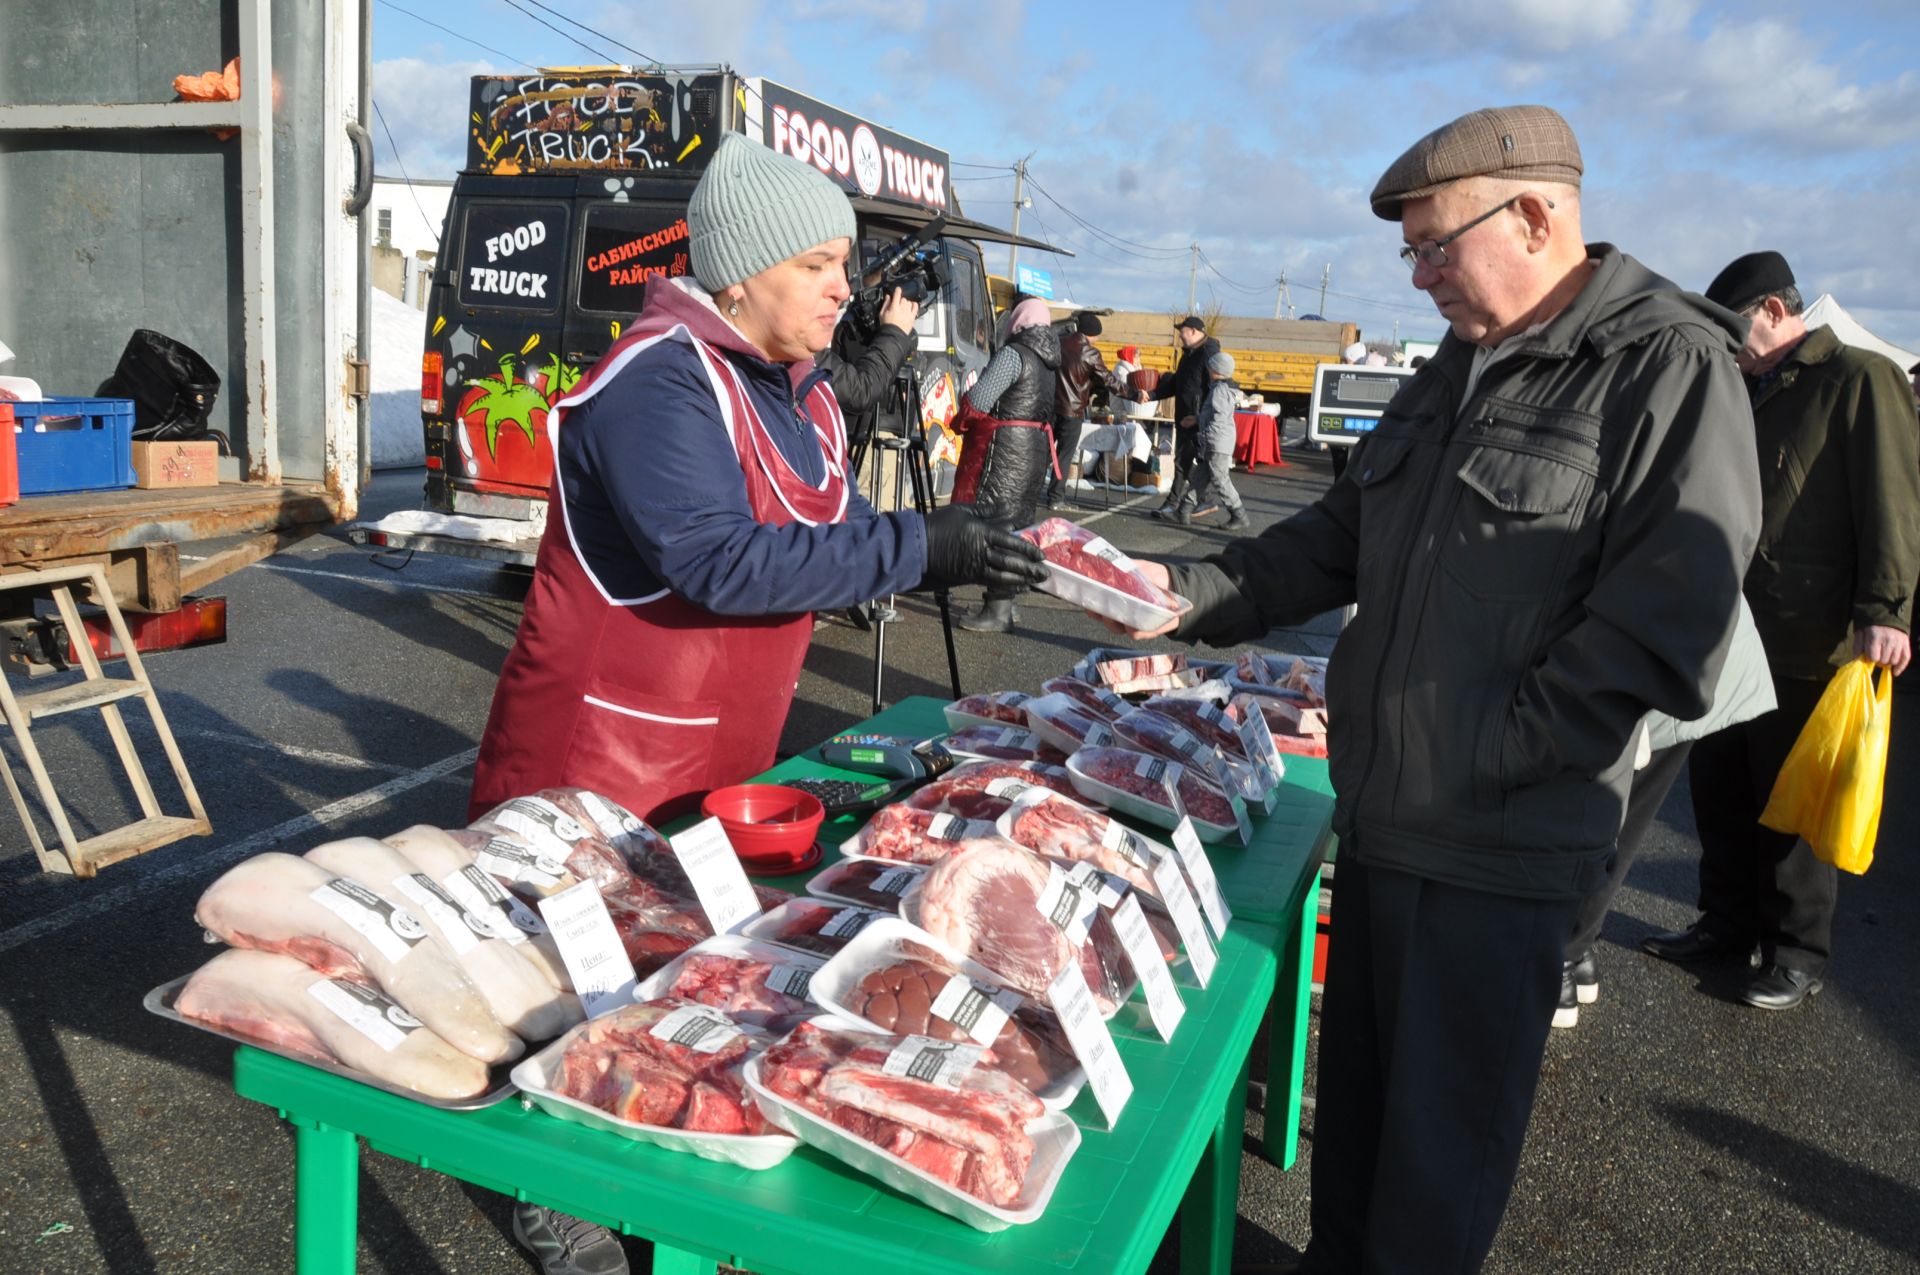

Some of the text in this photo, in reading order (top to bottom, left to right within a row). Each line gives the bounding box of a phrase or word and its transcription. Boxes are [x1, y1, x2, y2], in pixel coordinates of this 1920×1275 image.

[773, 105, 946, 206] FOOD TRUCK
[485, 220, 546, 263] FOOD
[587, 218, 689, 272] САБИНСКИЙ
[470, 267, 548, 298] TRUCK
